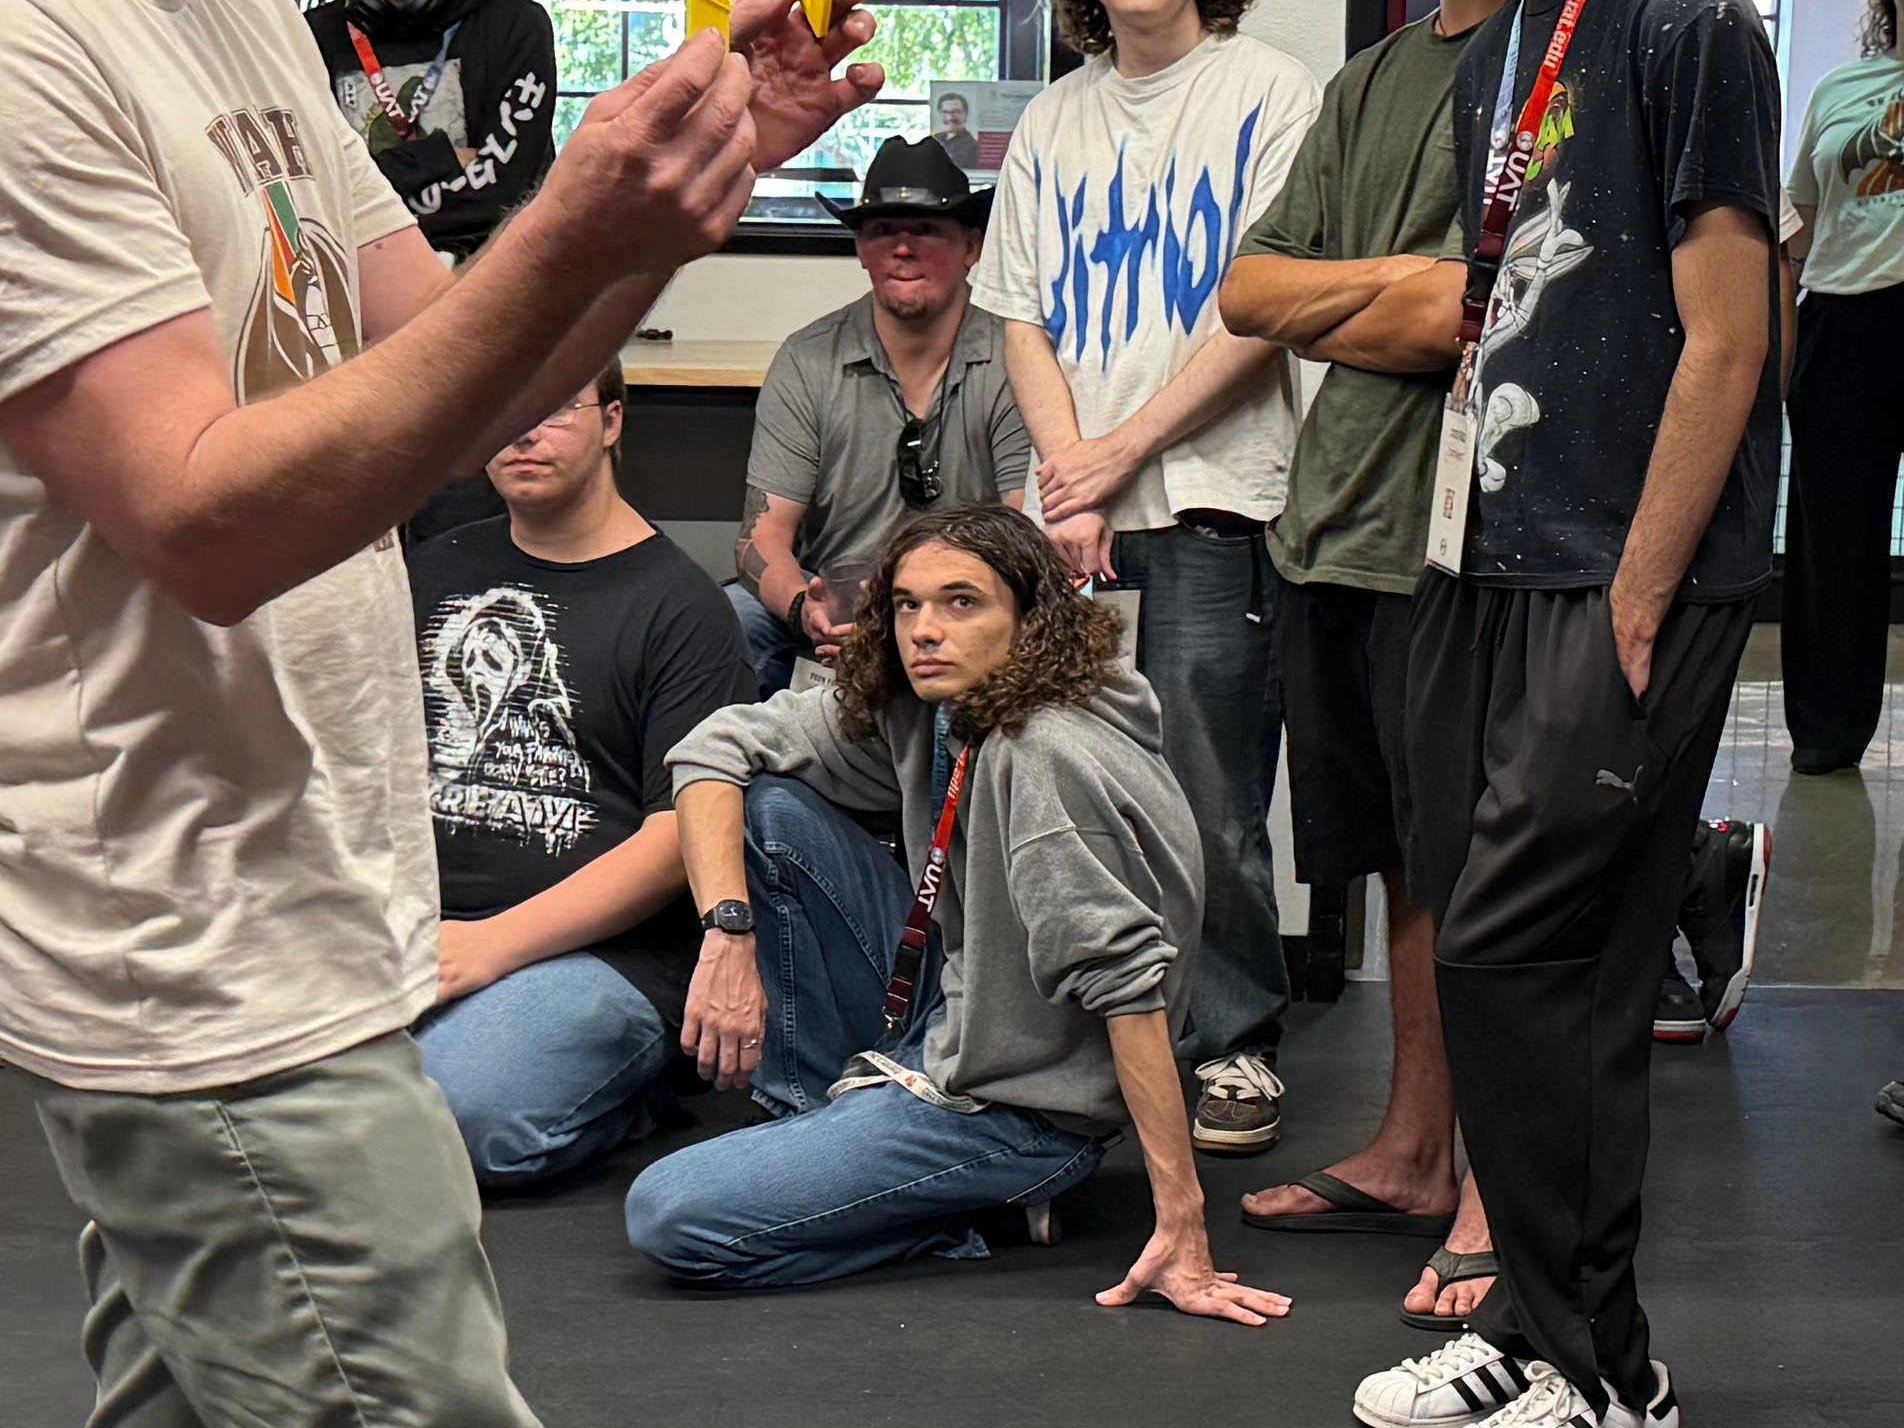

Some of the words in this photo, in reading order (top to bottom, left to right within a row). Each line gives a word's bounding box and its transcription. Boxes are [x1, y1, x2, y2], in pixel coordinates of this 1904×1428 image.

[376, 84, 406, 119] UAT
[1496, 150, 1531, 212] UAT
[917, 863, 943, 913] UAT
